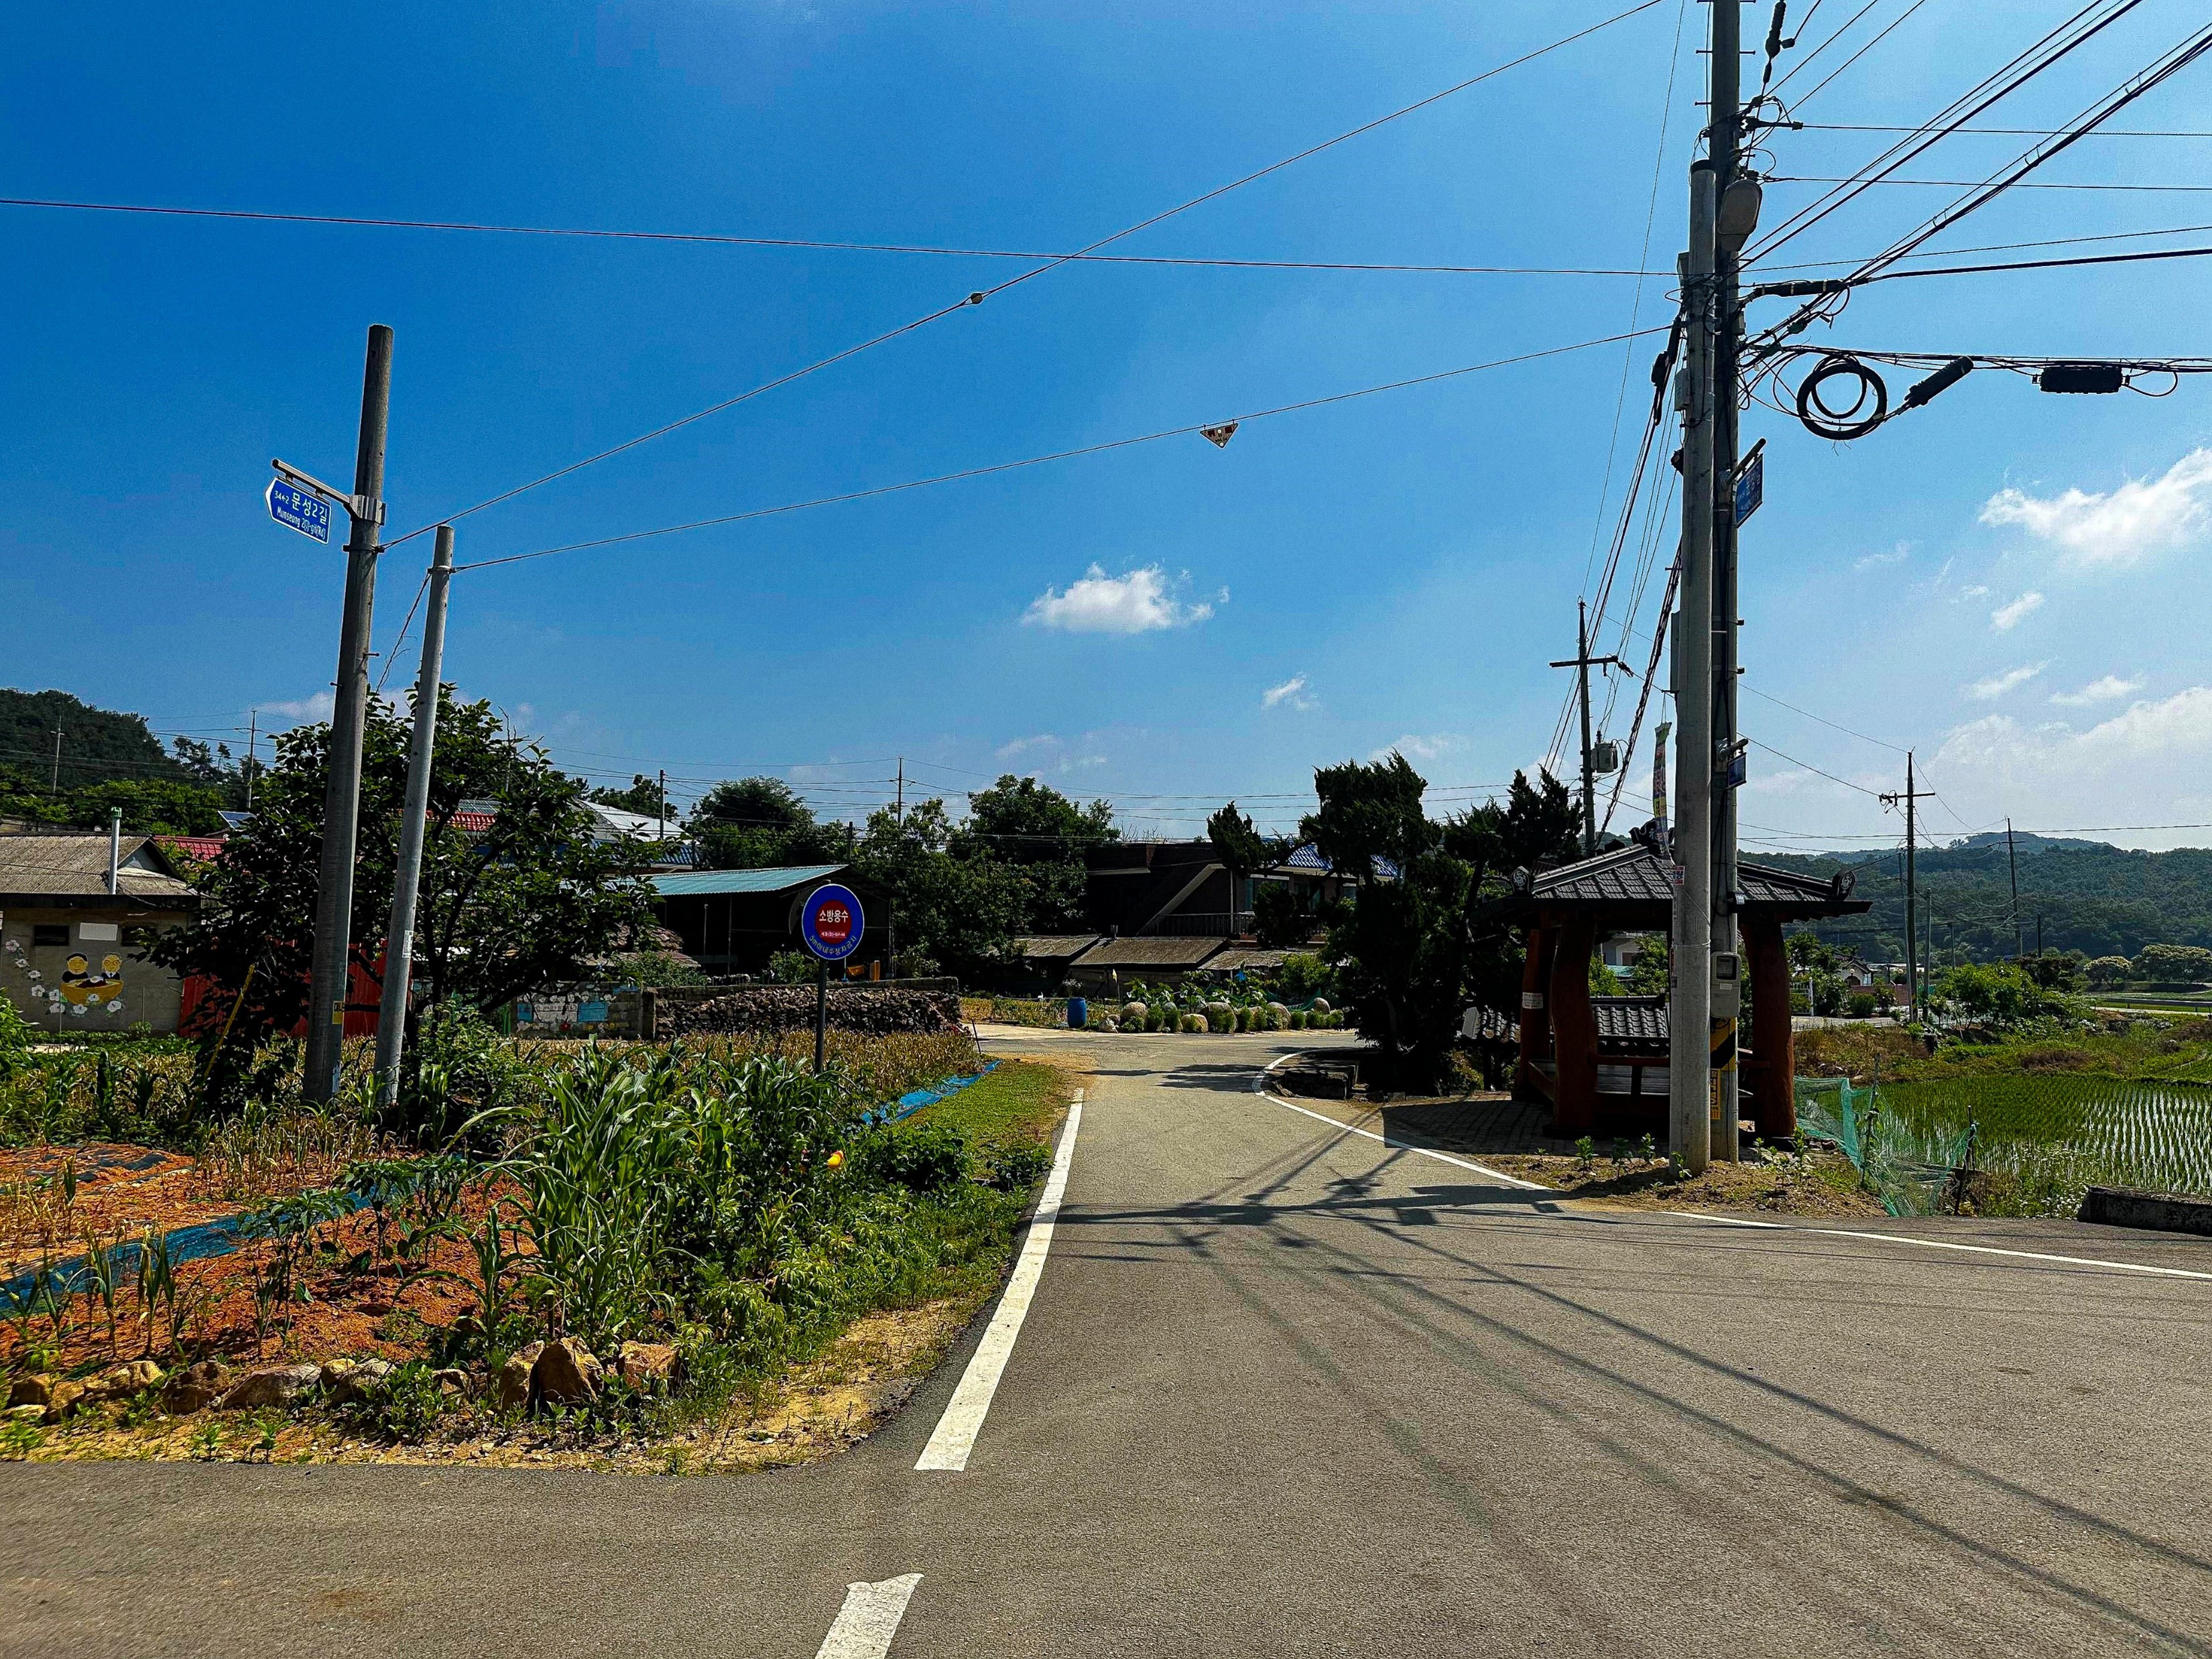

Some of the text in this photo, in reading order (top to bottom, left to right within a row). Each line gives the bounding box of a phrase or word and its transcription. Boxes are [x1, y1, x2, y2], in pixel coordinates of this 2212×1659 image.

[277, 506, 300, 528] Munseong
[292, 492, 327, 525] 문성2길
[818, 909, 849, 923] 소방용수
